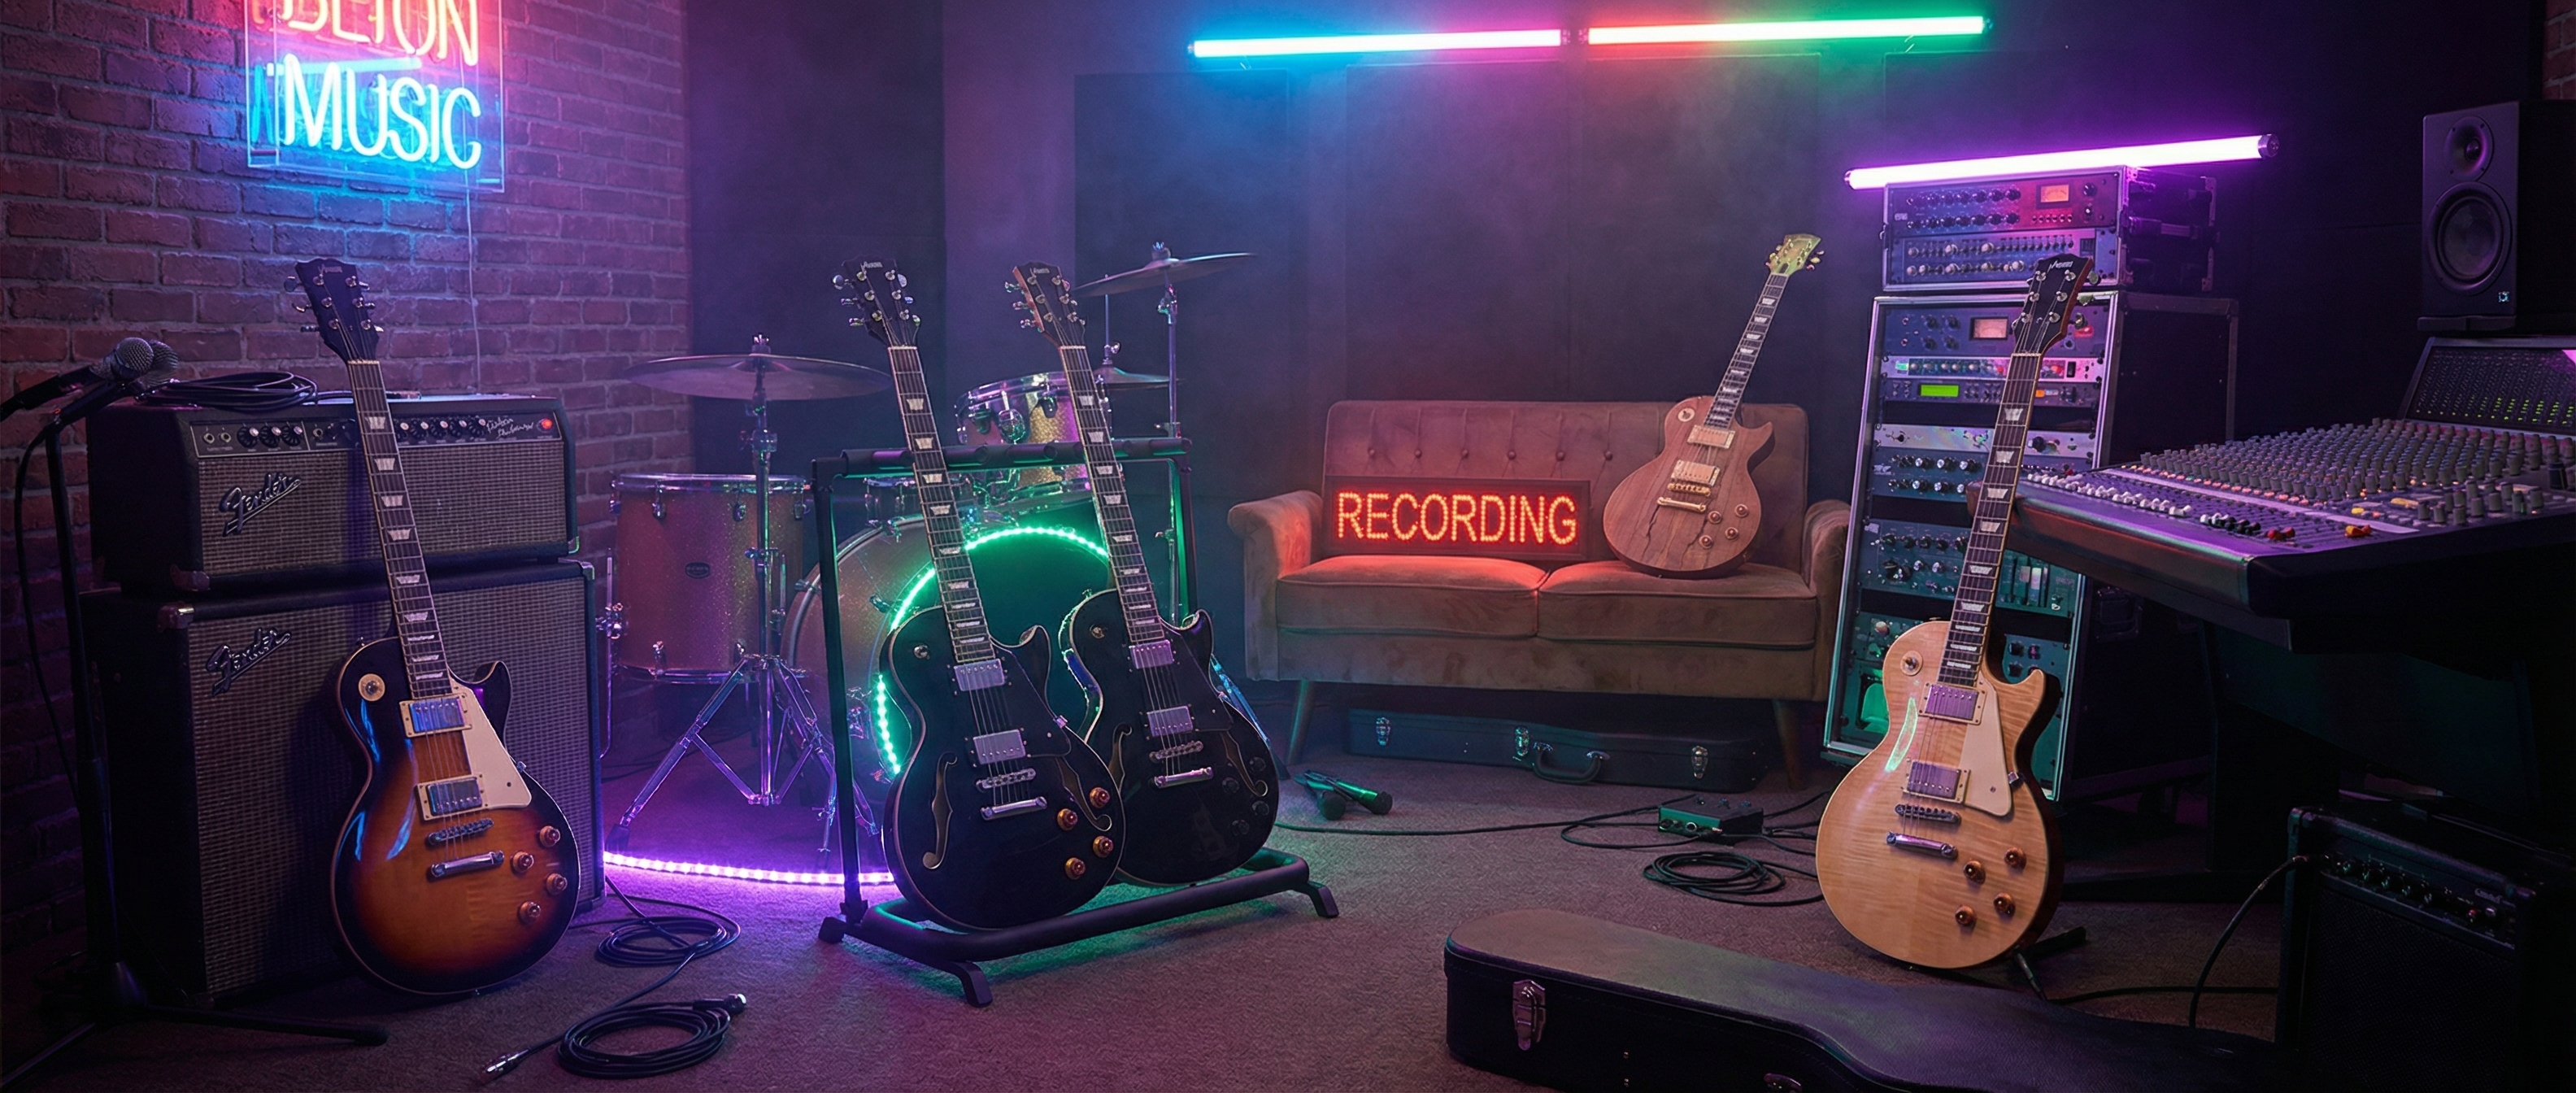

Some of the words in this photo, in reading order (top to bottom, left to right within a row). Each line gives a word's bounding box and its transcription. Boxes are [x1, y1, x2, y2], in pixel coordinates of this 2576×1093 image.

[284, 53, 482, 169] MUSIC
[220, 472, 302, 537] Fender
[1337, 491, 1577, 546] RECORDING
[206, 627, 291, 697] Fender
